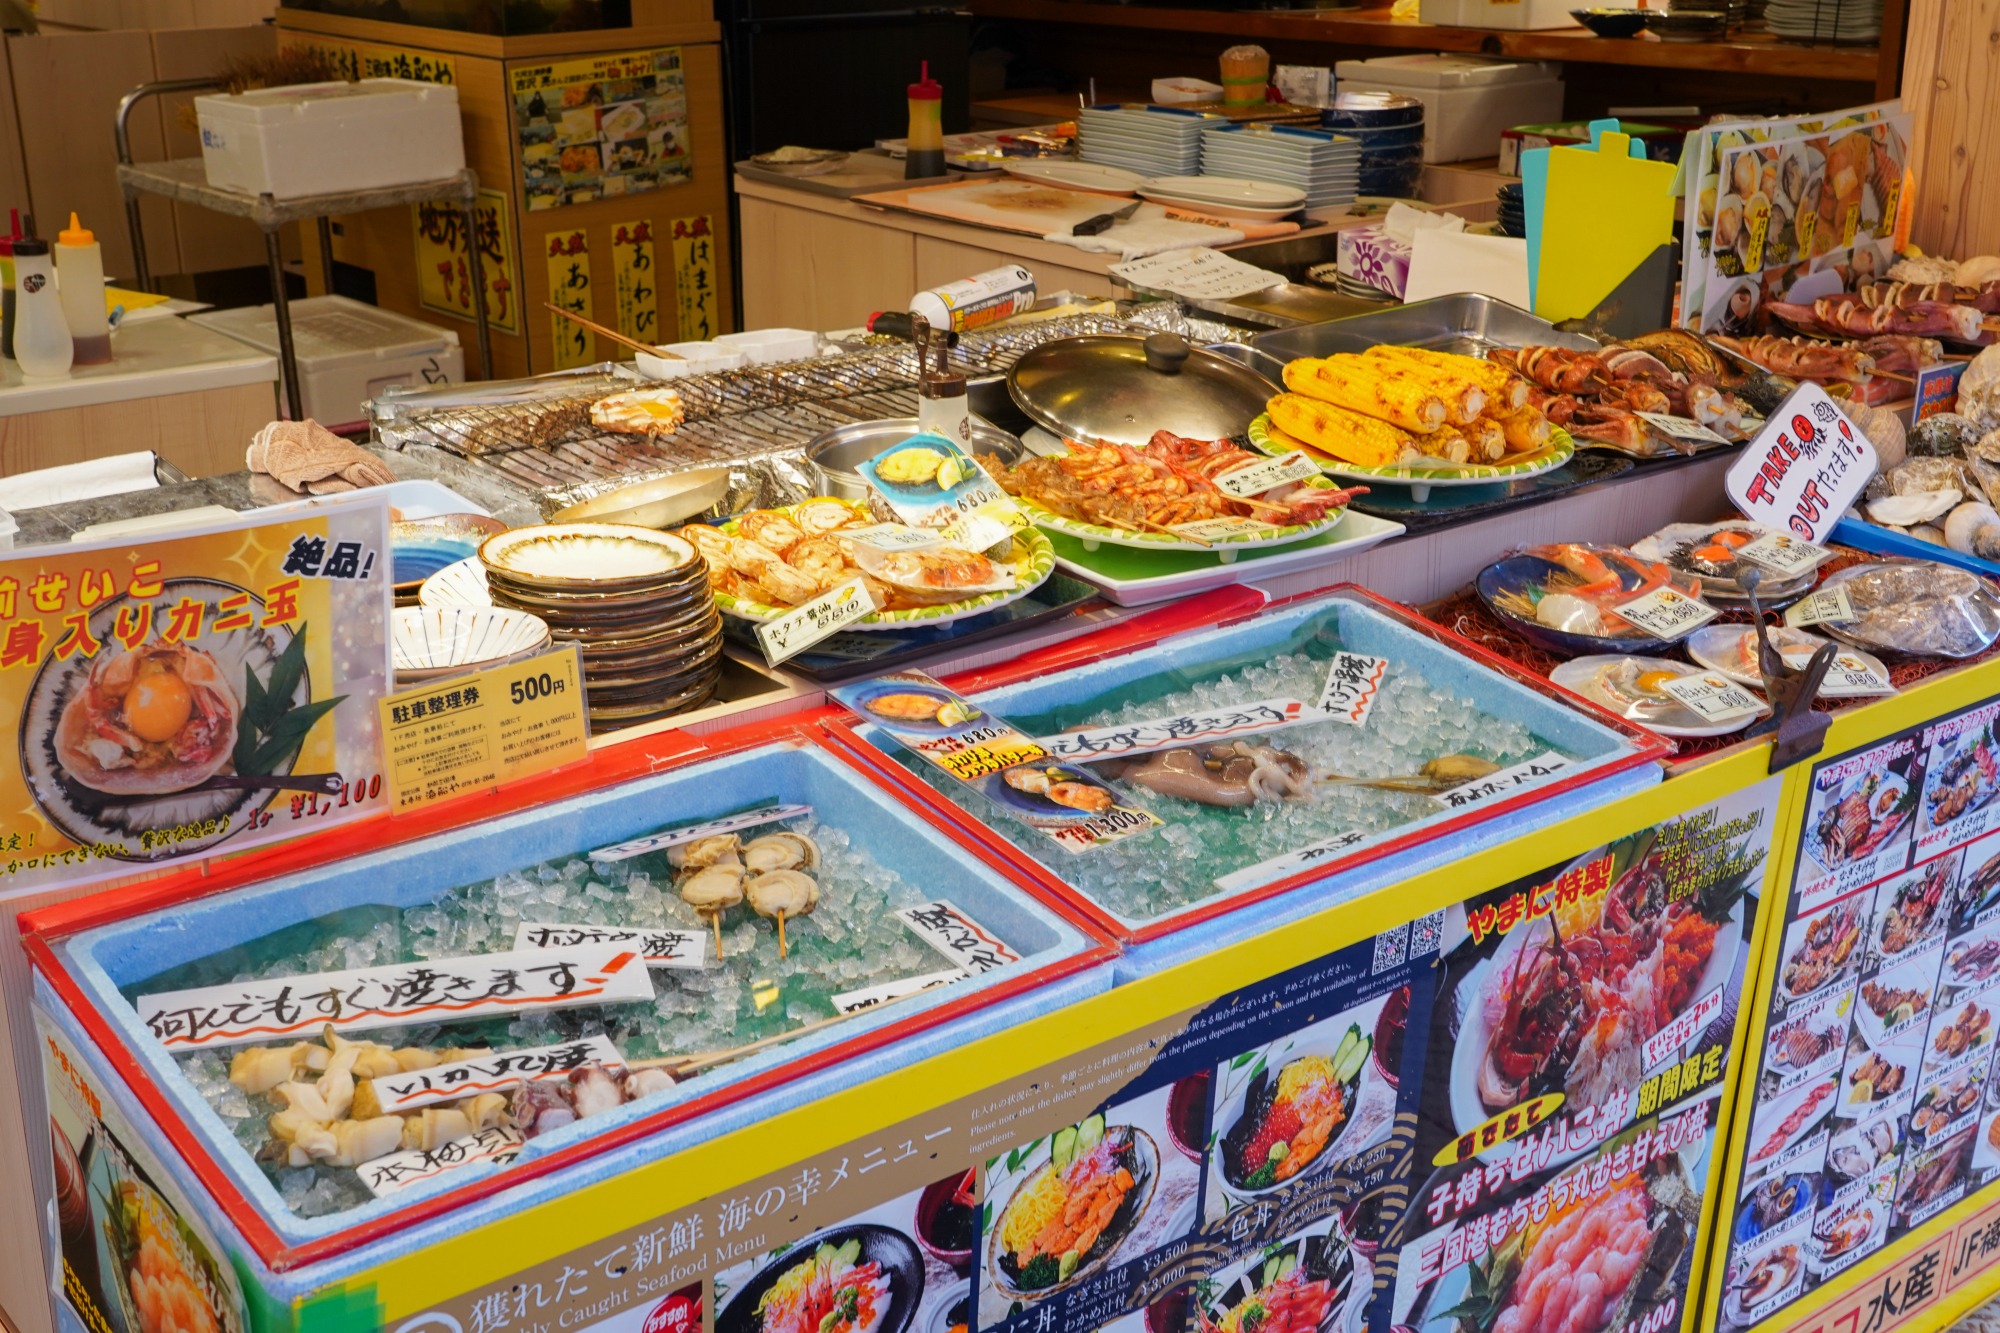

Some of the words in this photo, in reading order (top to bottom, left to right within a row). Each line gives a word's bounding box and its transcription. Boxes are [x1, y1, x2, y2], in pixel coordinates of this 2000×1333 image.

[567, 262, 589, 357] あさり
[632, 243, 656, 333] あわび
[689, 240, 712, 341] はまぐり
[1011, 290, 1036, 316] Pro
[1745, 432, 1801, 507] TAKE
[956, 488, 998, 513] 680円
[1788, 478, 1829, 542] OUT
[283, 535, 375, 579] 絶品!
[769, 602, 833, 641] ホタテ醤油
[391, 685, 480, 725] 駐車整理券
[509, 671, 565, 705] 500円
[919, 736, 957, 751] シングル
[961, 727, 1008, 745] 680円
[290, 773, 382, 819] ¥1,100
[1084, 811, 1151, 839] 1,300円
[1467, 853, 1616, 945] やまに特製
[969, 1117, 997, 1137] Please
[999, 1111, 1018, 1126] note
[1019, 1103, 1036, 1118] that
[1037, 1096, 1051, 1110] the
[1052, 1088, 1078, 1105] dishes
[1079, 1080, 1096, 1096] may
[1097, 1066, 1124, 1087] slightly
[1125, 1057, 1148, 1075] differ
[1149, 1050, 1167, 1064] from
[1168, 1045, 1182, 1057] the
[1182, 1036, 1208, 1055] photos
[1208, 1013, 1246, 1042] depending
[1247, 1013, 1258, 1025] on
[1258, 1007, 1271, 1021] the
[1271, 999, 1295, 1015] season
[1295, 993, 1309, 1009] and
[1310, 989, 1322, 1003] the
[1322, 974, 1359, 1000] availability
[1358, 968, 1368, 983] of
[968, 1128, 1017, 1154] ingredients.
[1347, 1147, 1387, 1175] ¥3,250
[1426, 1087, 1629, 1225] 子持ちせいこ丼
[1634, 1043, 1724, 1119] 期間限定
[1277, 1193, 1333, 1227] わかめ汁付
[1345, 1170, 1385, 1198] ¥2,750
[1416, 1100, 1710, 1290] 三国港もちもち丸むき甘えび丼
[468, 1214, 704, 1333] 獲れたて新鮮
[716, 1124, 953, 1238] 海の幸メニュー
[558, 1285, 630, 1328] Caught
[635, 1255, 708, 1298] Seafood
[715, 1230, 767, 1264] Menu
[1063, 1292, 1127, 1332] わかめ汁付
[1140, 1264, 1187, 1298] ¥3,000
[1065, 1267, 1128, 1307] なぎさ汁付
[1142, 1240, 1188, 1273] ¥3,500
[649, 1302, 690, 1333] おすすめ!
